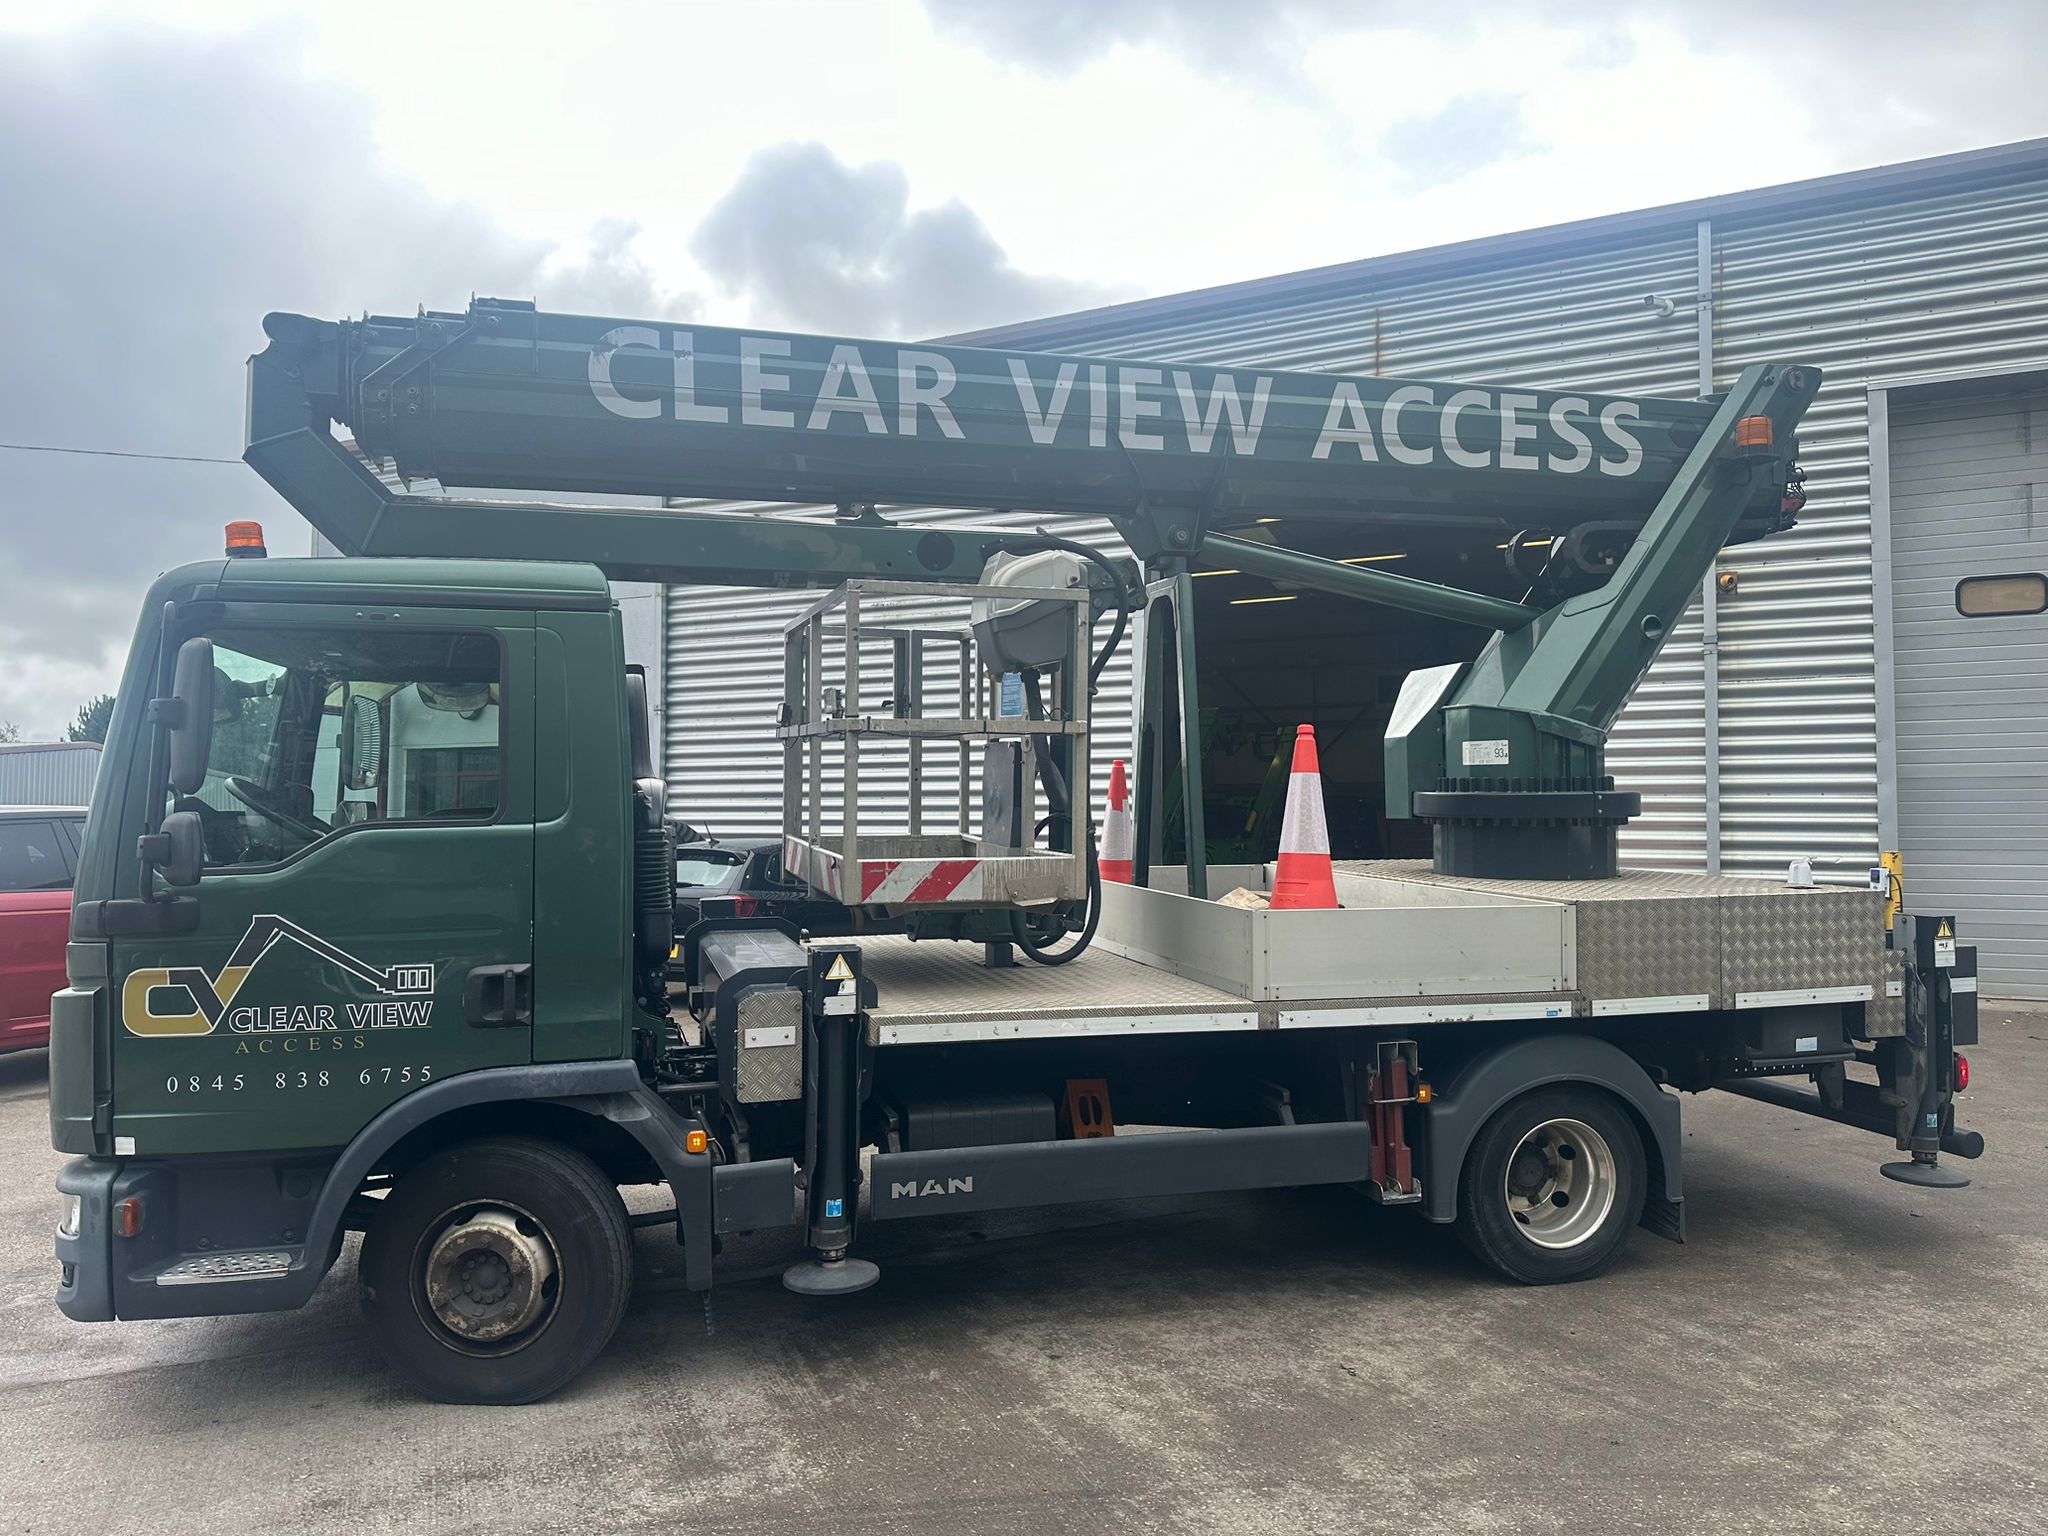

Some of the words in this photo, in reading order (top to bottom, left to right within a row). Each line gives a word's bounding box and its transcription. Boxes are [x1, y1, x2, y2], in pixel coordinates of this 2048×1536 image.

[587, 325, 966, 440] CLEAR
[1006, 358, 1273, 456] VIEW
[1312, 381, 1643, 476] ACCESS
[228, 1004, 337, 1033] CLEAR
[346, 1001, 433, 1028] VIEW
[235, 1035, 365, 1054] ACCESS
[167, 1074, 244, 1093] 0845
[275, 1070, 330, 1089] 838
[359, 1065, 431, 1085] 6755
[890, 1175, 974, 1200] MAN
